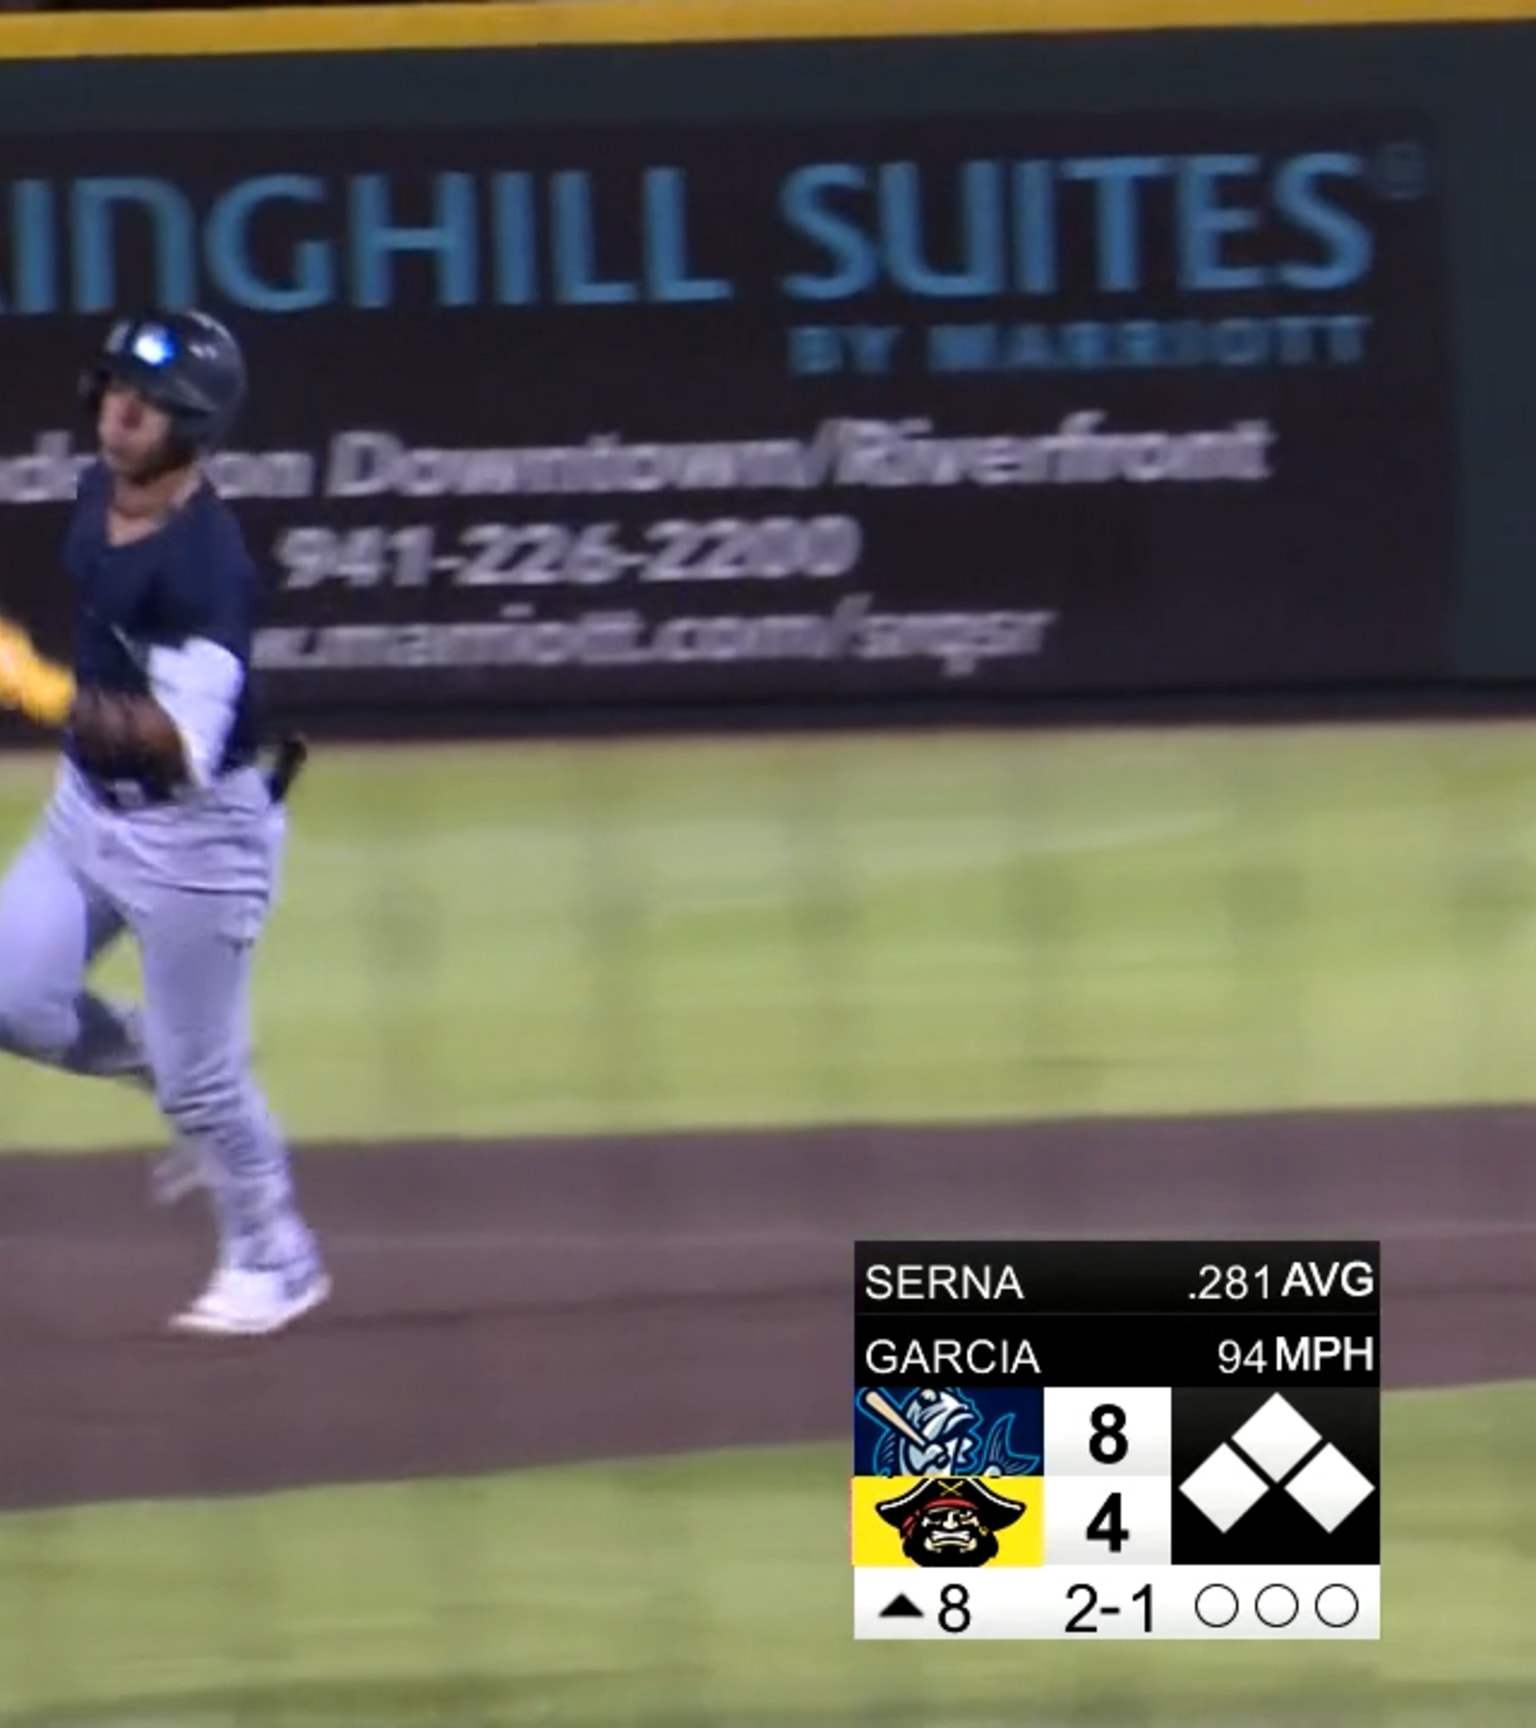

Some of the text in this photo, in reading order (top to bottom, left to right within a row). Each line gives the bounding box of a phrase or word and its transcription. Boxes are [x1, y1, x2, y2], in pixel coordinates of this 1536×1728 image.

[780, 152, 1374, 300] SUITES
[789, 314, 1368, 374] BY MARRIOTT
[278, 516, 862, 588] 941-226-2200
